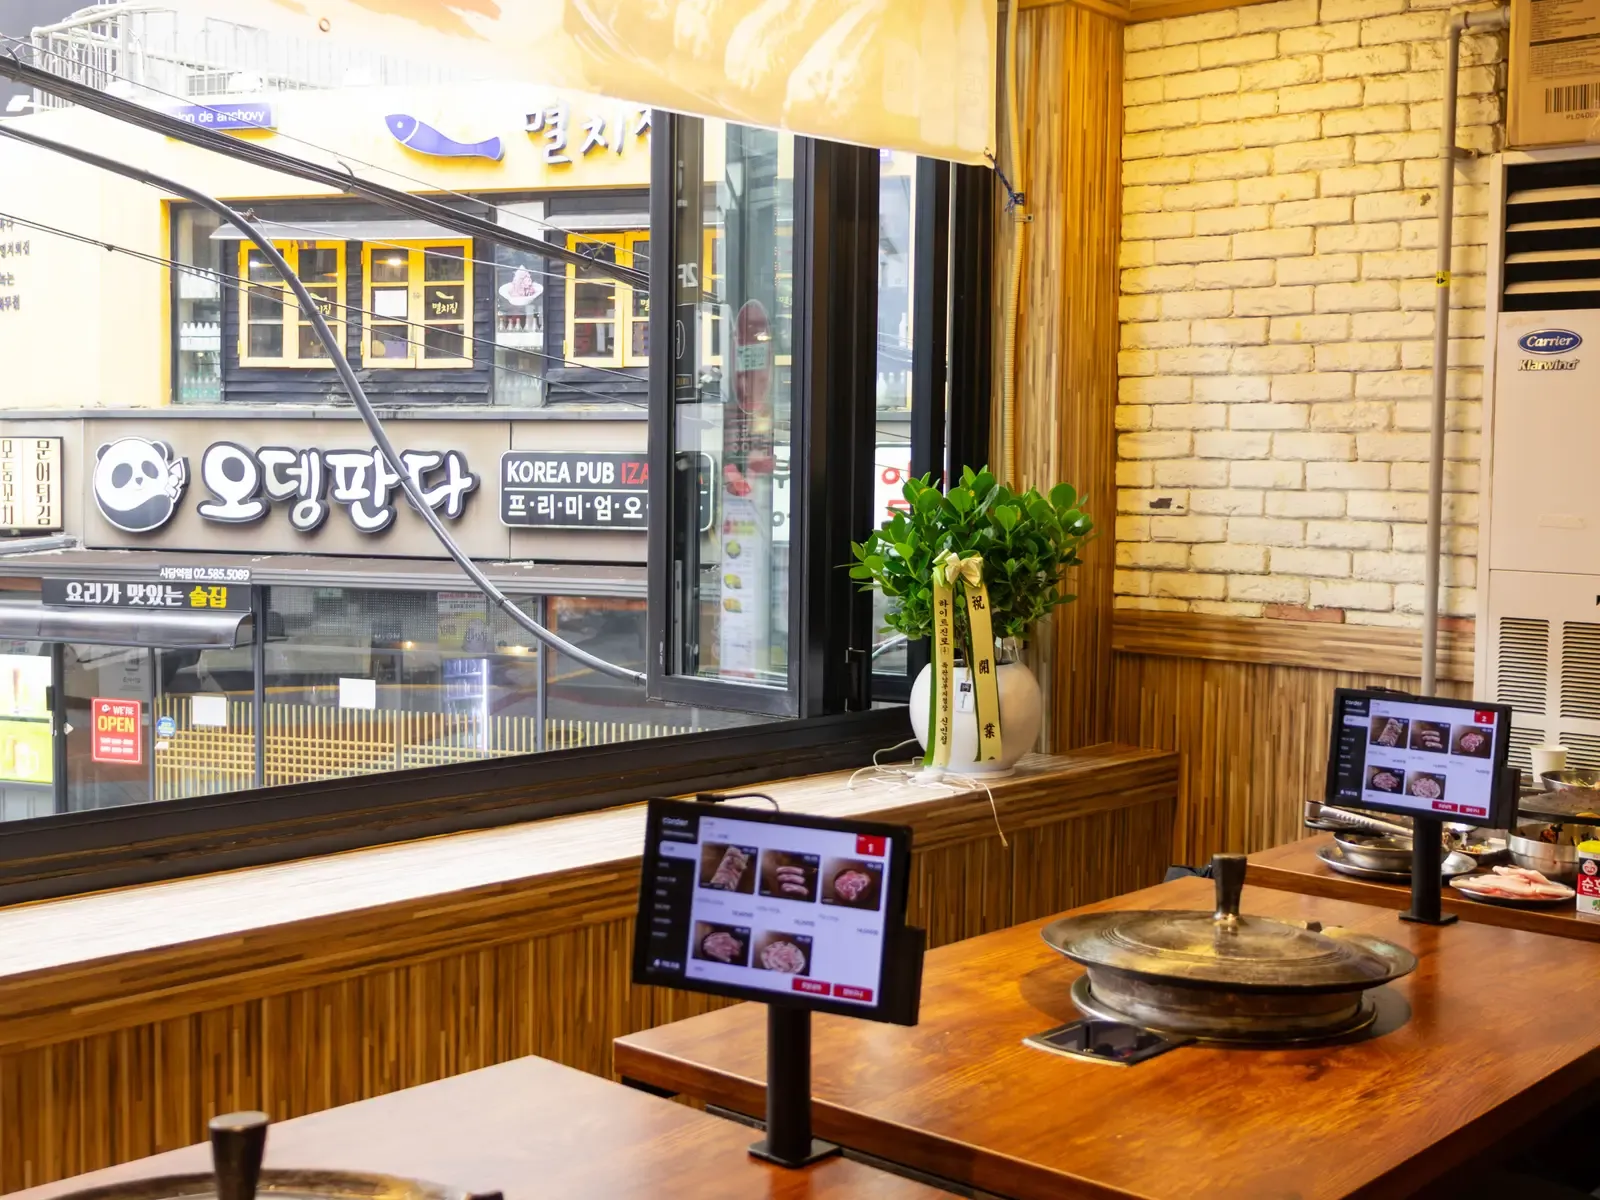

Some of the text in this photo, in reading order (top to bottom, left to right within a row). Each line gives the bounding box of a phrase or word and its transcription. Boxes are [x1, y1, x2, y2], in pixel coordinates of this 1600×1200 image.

[198, 110, 213, 122] de
[217, 108, 264, 122] anchovy
[524, 98, 651, 164] 멸치
[432, 302, 458, 315] 멸치집
[1526, 335, 1574, 347] Carrier
[36, 439, 51, 526] 문어튀김
[507, 460, 571, 484] KOREA
[576, 461, 615, 484] PUB
[199, 443, 474, 530] 오뎅판다
[65, 582, 228, 608] 요리가 맛있는 술집
[113, 705, 135, 715] WE'RE
[98, 715, 135, 733] OPEN
